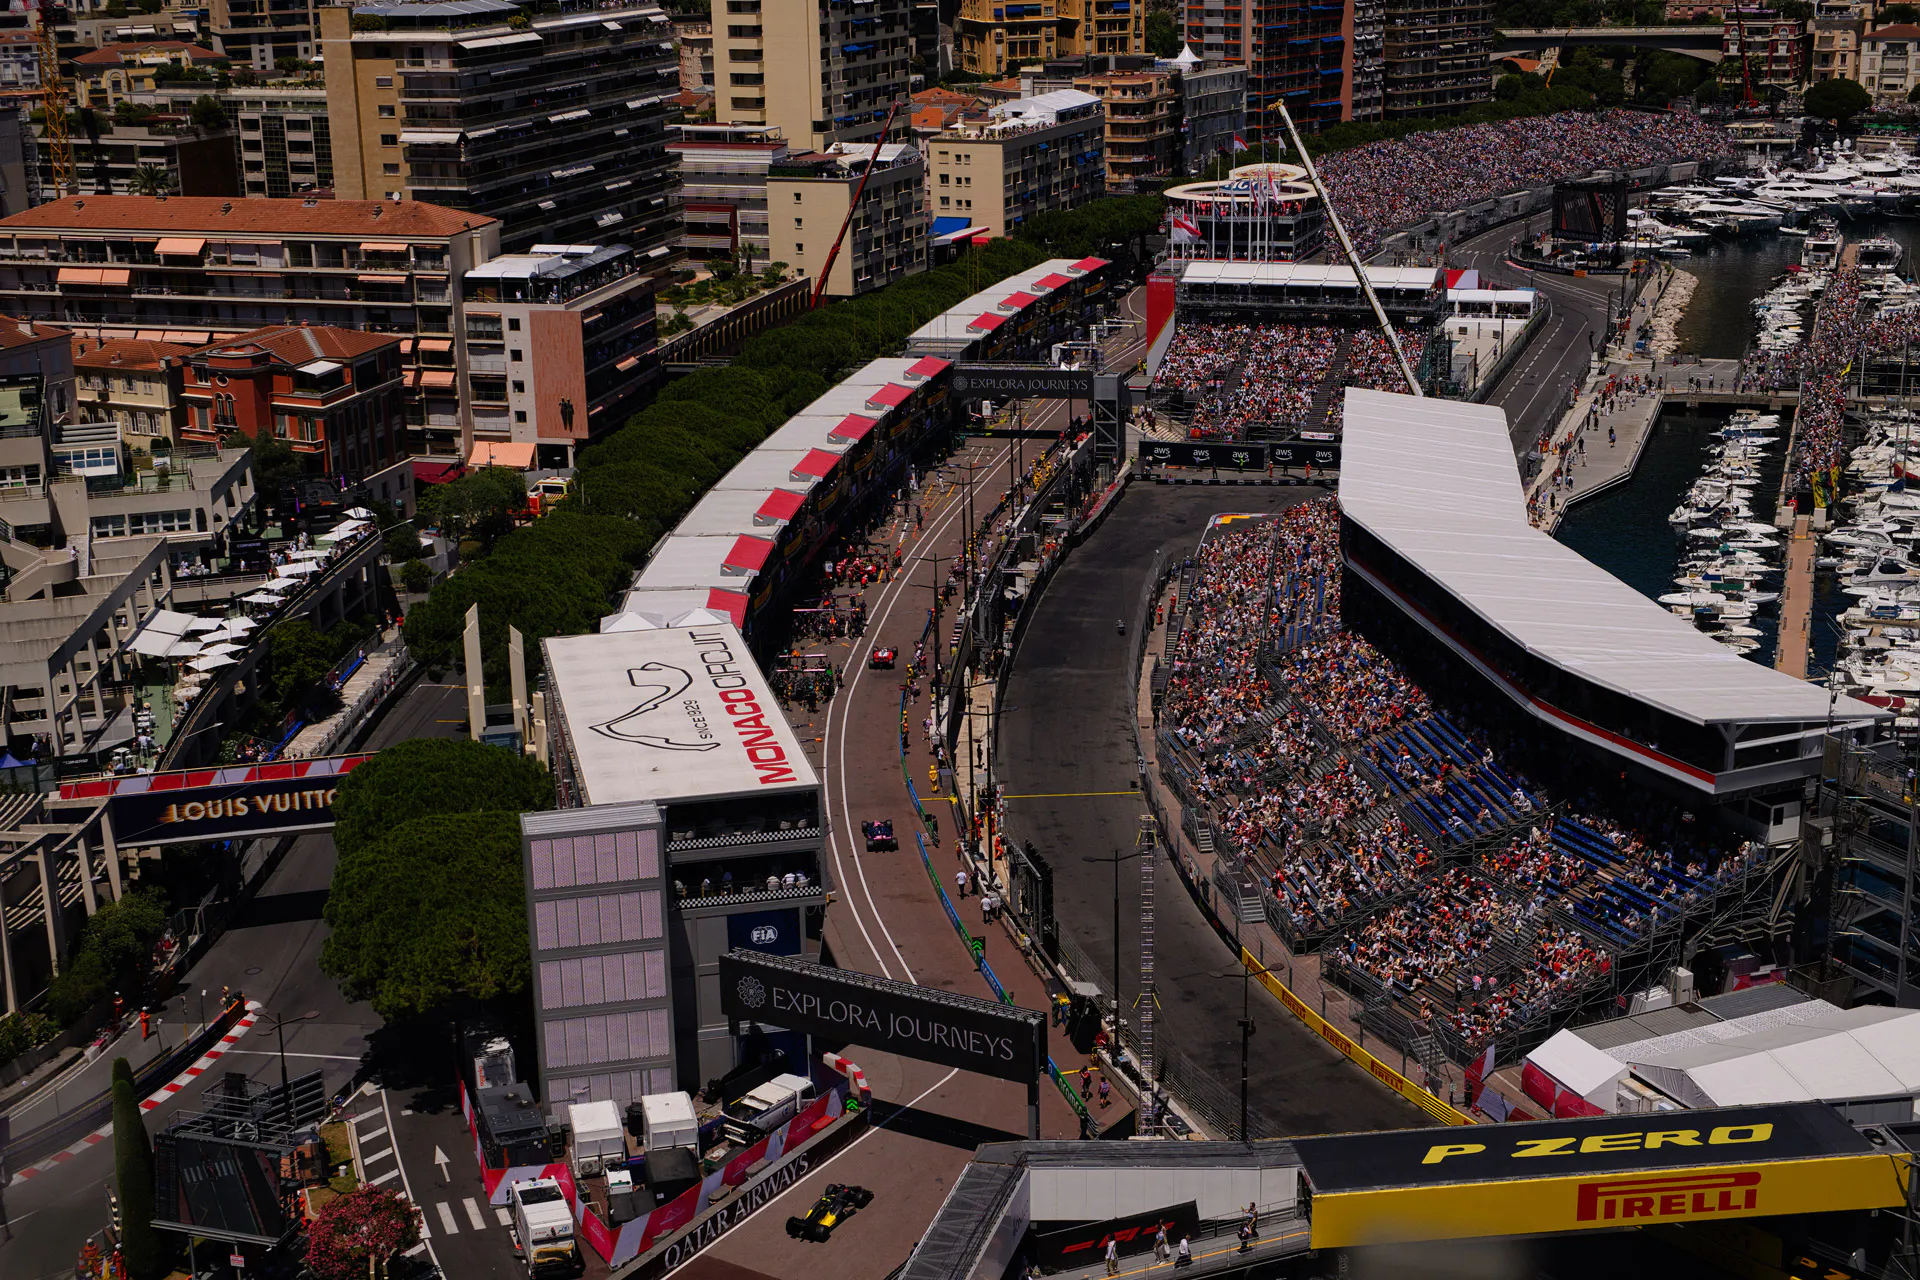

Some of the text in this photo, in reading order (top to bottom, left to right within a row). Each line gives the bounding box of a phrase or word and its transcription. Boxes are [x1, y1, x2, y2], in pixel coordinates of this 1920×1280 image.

[971, 378, 1088, 392] EXPLORA JOURNEYS
[1153, 447, 1171, 456] aws
[1192, 449, 1210, 458] aws
[1232, 451, 1249, 459] aws
[1275, 448, 1292, 457] aws
[1315, 450, 1333, 459] aws
[688, 631, 798, 785] MONACO CIRCUIT
[170, 796, 249, 823] LOUIS
[752, 928, 777, 942] FIA
[1281, 989, 1306, 1020] PIRELLI
[772, 986, 1014, 1061] EXPLORA JOURNEYS
[1322, 1023, 1352, 1056] PIRELLI
[1370, 1059, 1404, 1092] PIRELLI
[1421, 1122, 1774, 1165] P ZERO
[664, 1151, 810, 1270] QATAR AIRWAYS
[1576, 1171, 1762, 1222] PIRELLI
